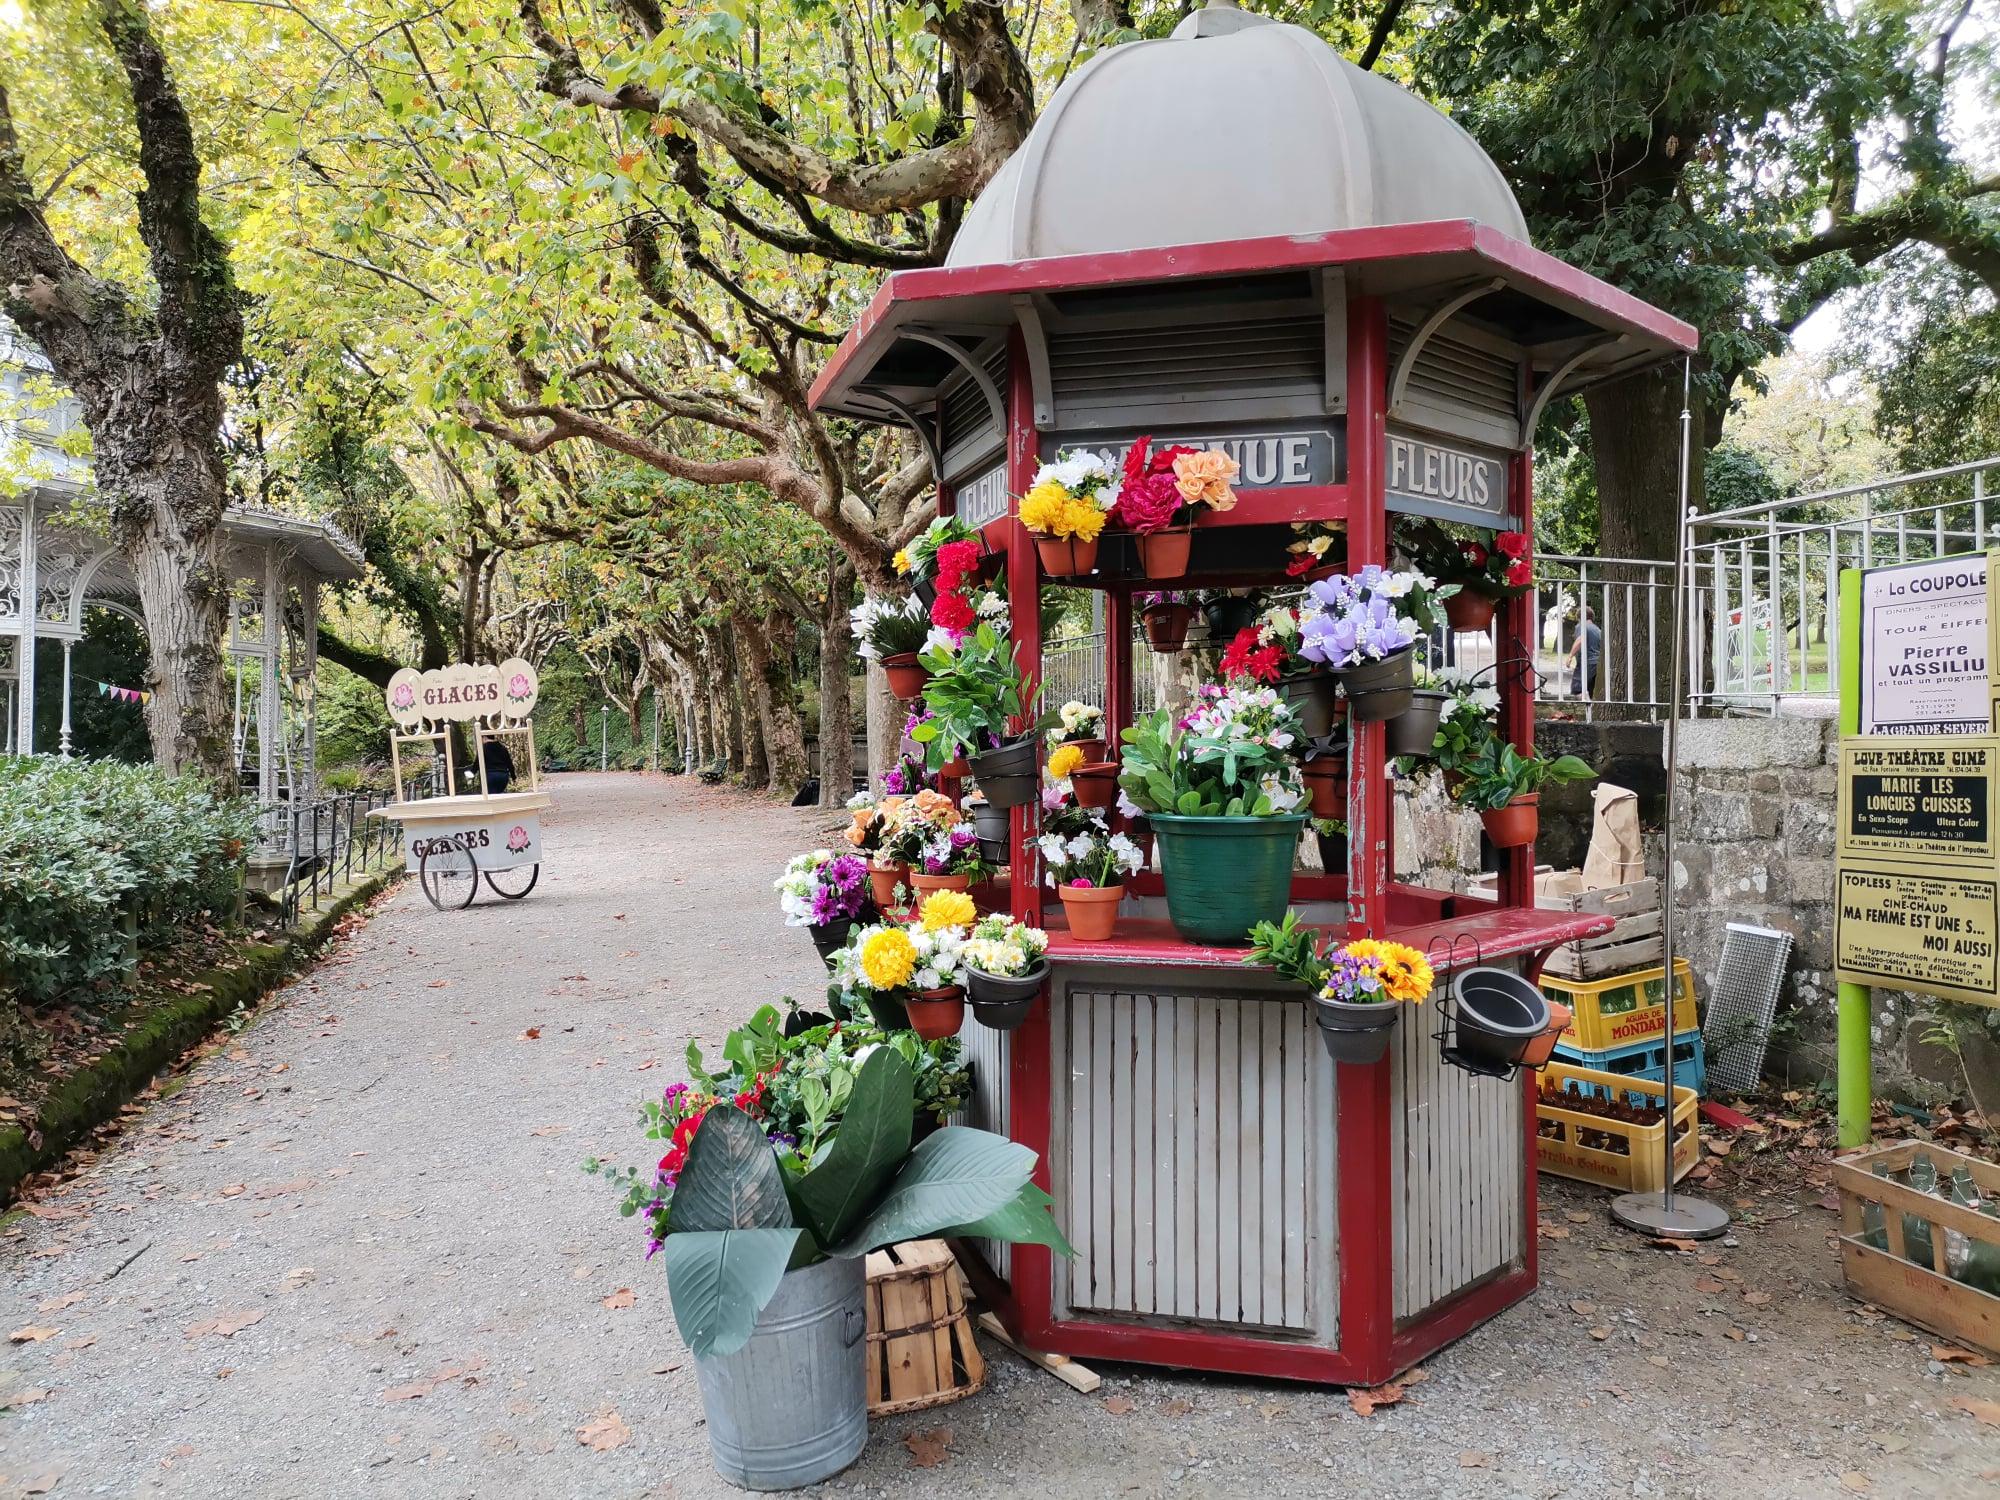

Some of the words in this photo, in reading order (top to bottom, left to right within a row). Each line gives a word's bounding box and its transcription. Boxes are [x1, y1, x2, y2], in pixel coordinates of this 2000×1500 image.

[1391, 440, 1489, 506] FLEURS
[965, 468, 1007, 528] FLEUR
[1889, 582, 1905, 596] La
[1909, 571, 1987, 594] COUPOLE
[1884, 625, 1928, 636] TOUR
[1903, 645, 1968, 660] Pierre
[1888, 658, 1985, 677] VASSILIU
[1893, 678, 1914, 686] tout
[423, 683, 498, 706] GLACES
[1881, 777, 1922, 793] MARIE
[1931, 778, 1954, 794] LES
[1866, 795, 1916, 812] LONGUES
[1922, 797, 1973, 814] CUISSES
[1858, 814, 1867, 822] En
[1936, 817, 1956, 827] Ultra
[1958, 818, 1980, 828] Color
[412, 829, 490, 858] GLACES
[1844, 875, 1892, 890] TOPLESS
[1843, 905, 1862, 921] MA
[1865, 908, 1906, 927] FEMME
[1909, 913, 1931, 930] EST
[1935, 916, 1961, 934] UNE
[1965, 919, 1986, 935] S...
[1848, 943, 1863, 953] Une
[1866, 946, 1929, 962] hyperproduction
[1922, 934, 1949, 952] MOI
[1953, 939, 1992, 958] AUSSI
[1841, 957, 1880, 970] PERMANENT
[1883, 964, 1893, 972] DE
[1625, 1011, 1650, 1024] AGUAS
[1651, 1009, 1662, 1018] DE
